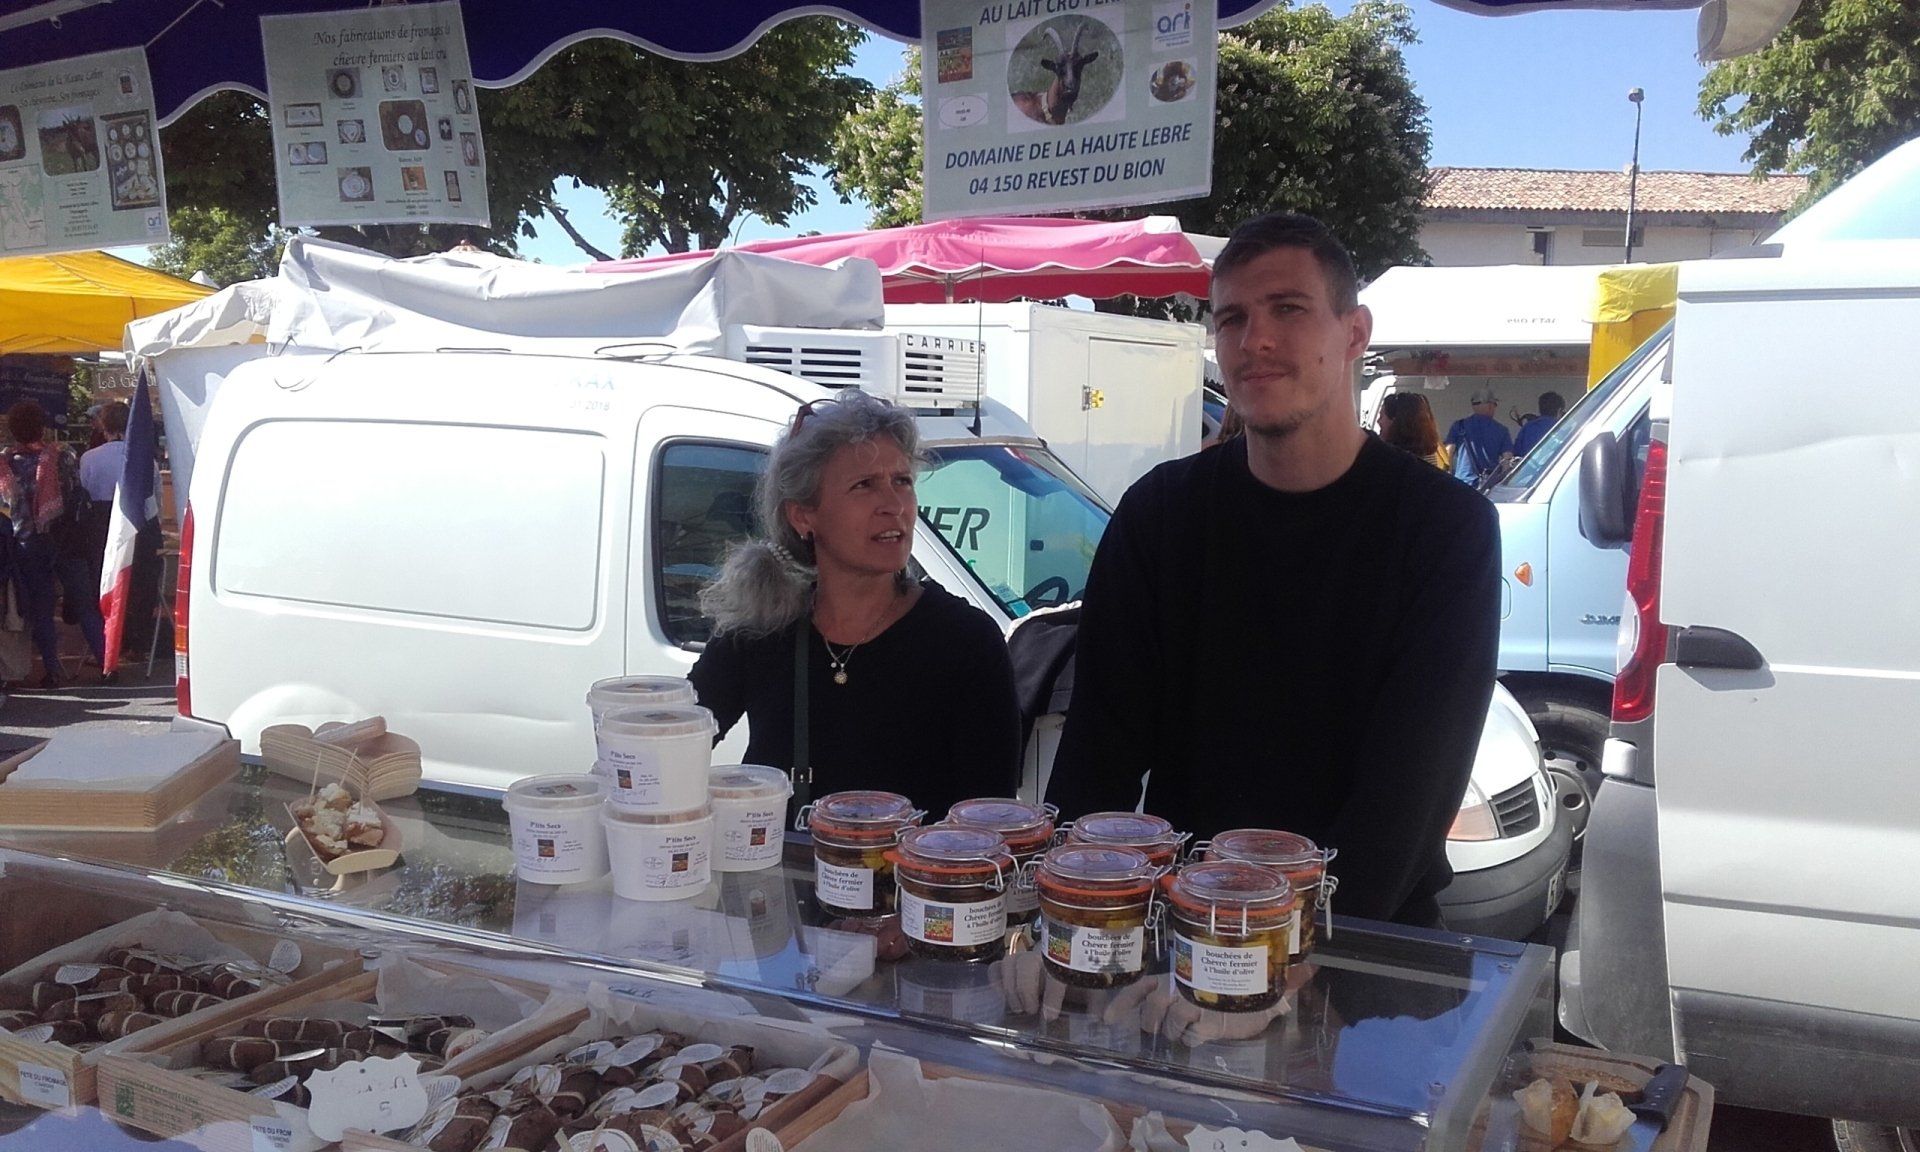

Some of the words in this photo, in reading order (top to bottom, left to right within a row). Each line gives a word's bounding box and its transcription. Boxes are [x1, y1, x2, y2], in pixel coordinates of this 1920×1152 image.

[979, 8, 1001, 26] AU
[1007, 0, 1040, 21] LAIT
[1157, 3, 1191, 35] ari
[945, 144, 1025, 170] DOMAINE
[1029, 141, 1052, 161] DE
[1055, 138, 1076, 157] LA
[1080, 130, 1138, 156] HAUTE
[1141, 122, 1193, 148] LEBRE
[969, 177, 988, 196] 04
[993, 174, 1024, 194] 150
[1027, 168, 1090, 190] REVEST
[1093, 164, 1119, 185] DU
[1123, 158, 1167, 180] BION
[906, 335, 986, 354] CARRIER
[839, 877, 863, 886] fermier
[964, 913, 987, 922] Chèvre
[1087, 932, 1122, 941] bouchées
[1081, 940, 1109, 949] Chèvre
[1110, 941, 1135, 949] fermier
[1111, 948, 1132, 956] d'olive
[1205, 948, 1242, 960] bouchées
[1243, 951, 1254, 959] de
[1201, 956, 1228, 967] Chèvre
[1229, 959, 1258, 968] fermier
[1209, 966, 1231, 975] l'huile
[1232, 968, 1255, 976] d'olive
